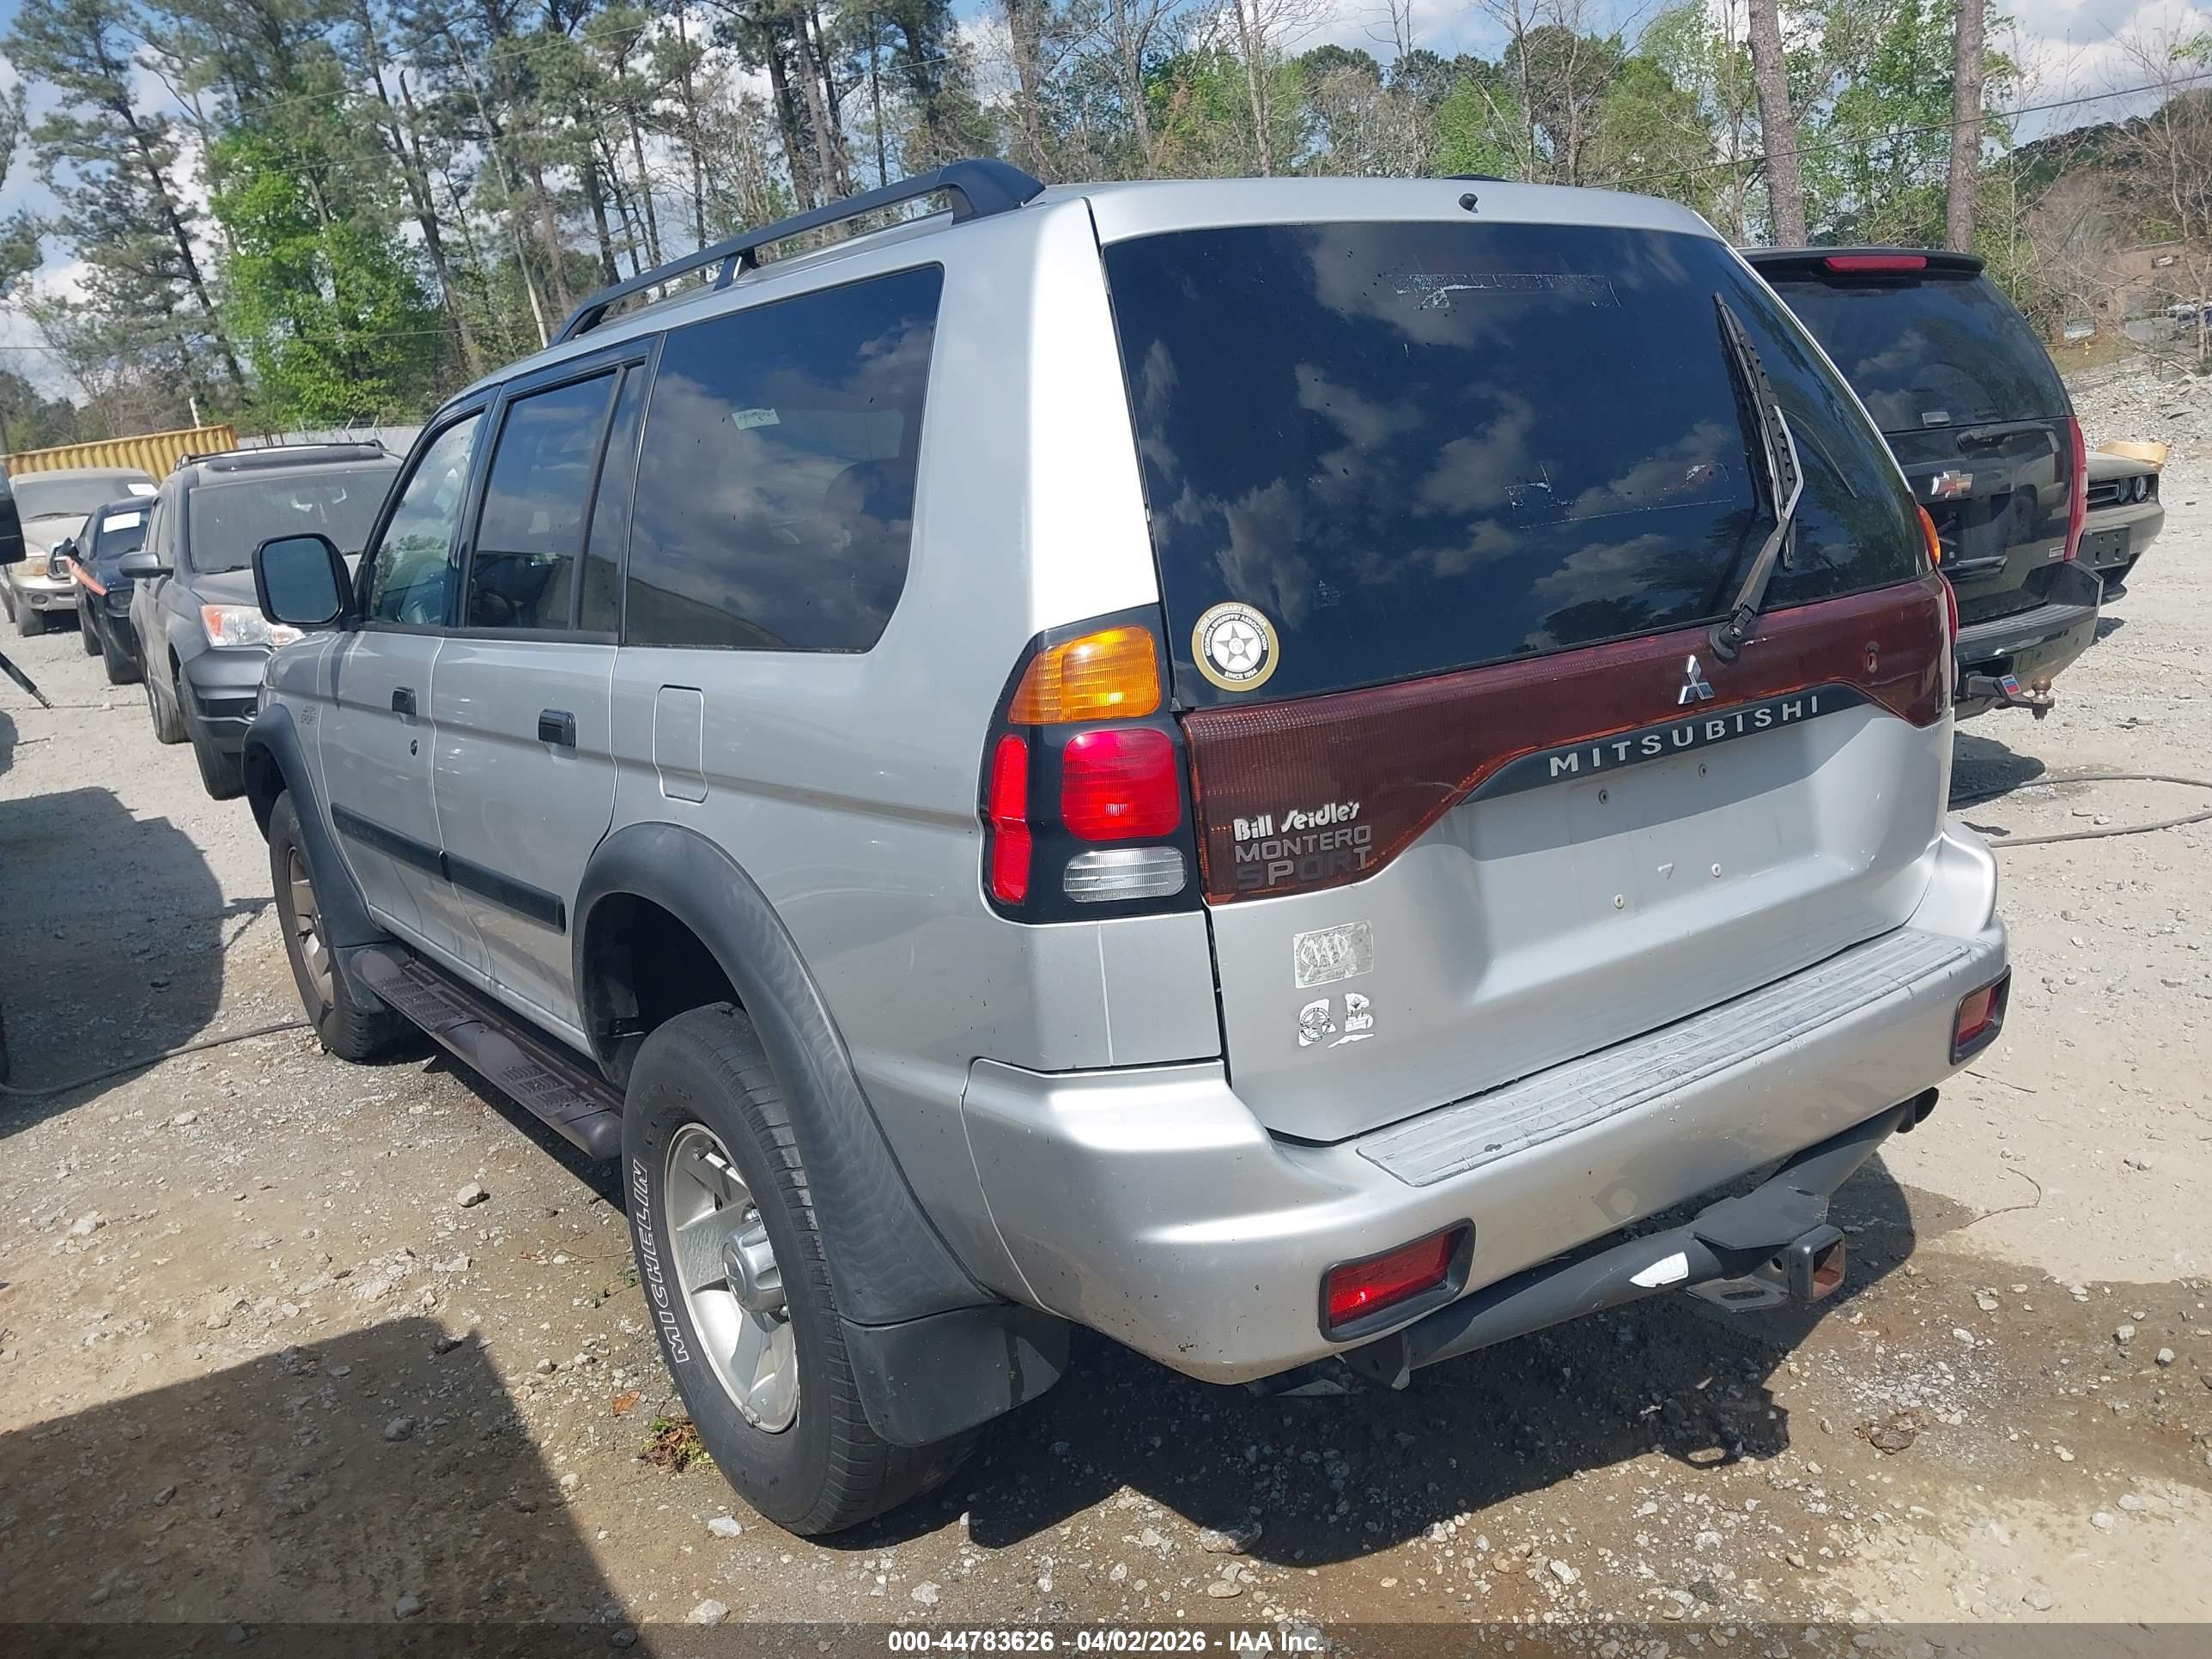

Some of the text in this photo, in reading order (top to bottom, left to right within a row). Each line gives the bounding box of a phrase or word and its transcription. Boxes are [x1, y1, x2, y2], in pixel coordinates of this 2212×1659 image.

[1204, 627, 1214, 657] GEORGIA
[1240, 615, 1268, 651] ASSOCIATION
[1207, 605, 1243, 622] HONORARY
[1243, 605, 1268, 628] MEMBER
[1224, 671, 1243, 680] SINCE
[1549, 696, 1819, 777] MITSUBISHI
[1233, 800, 1360, 842] Bill Seidle's
[1235, 825, 1371, 863] MONTERO
[1236, 845, 1372, 891] SPORT
[633, 1158, 690, 1364] MICHELIN
